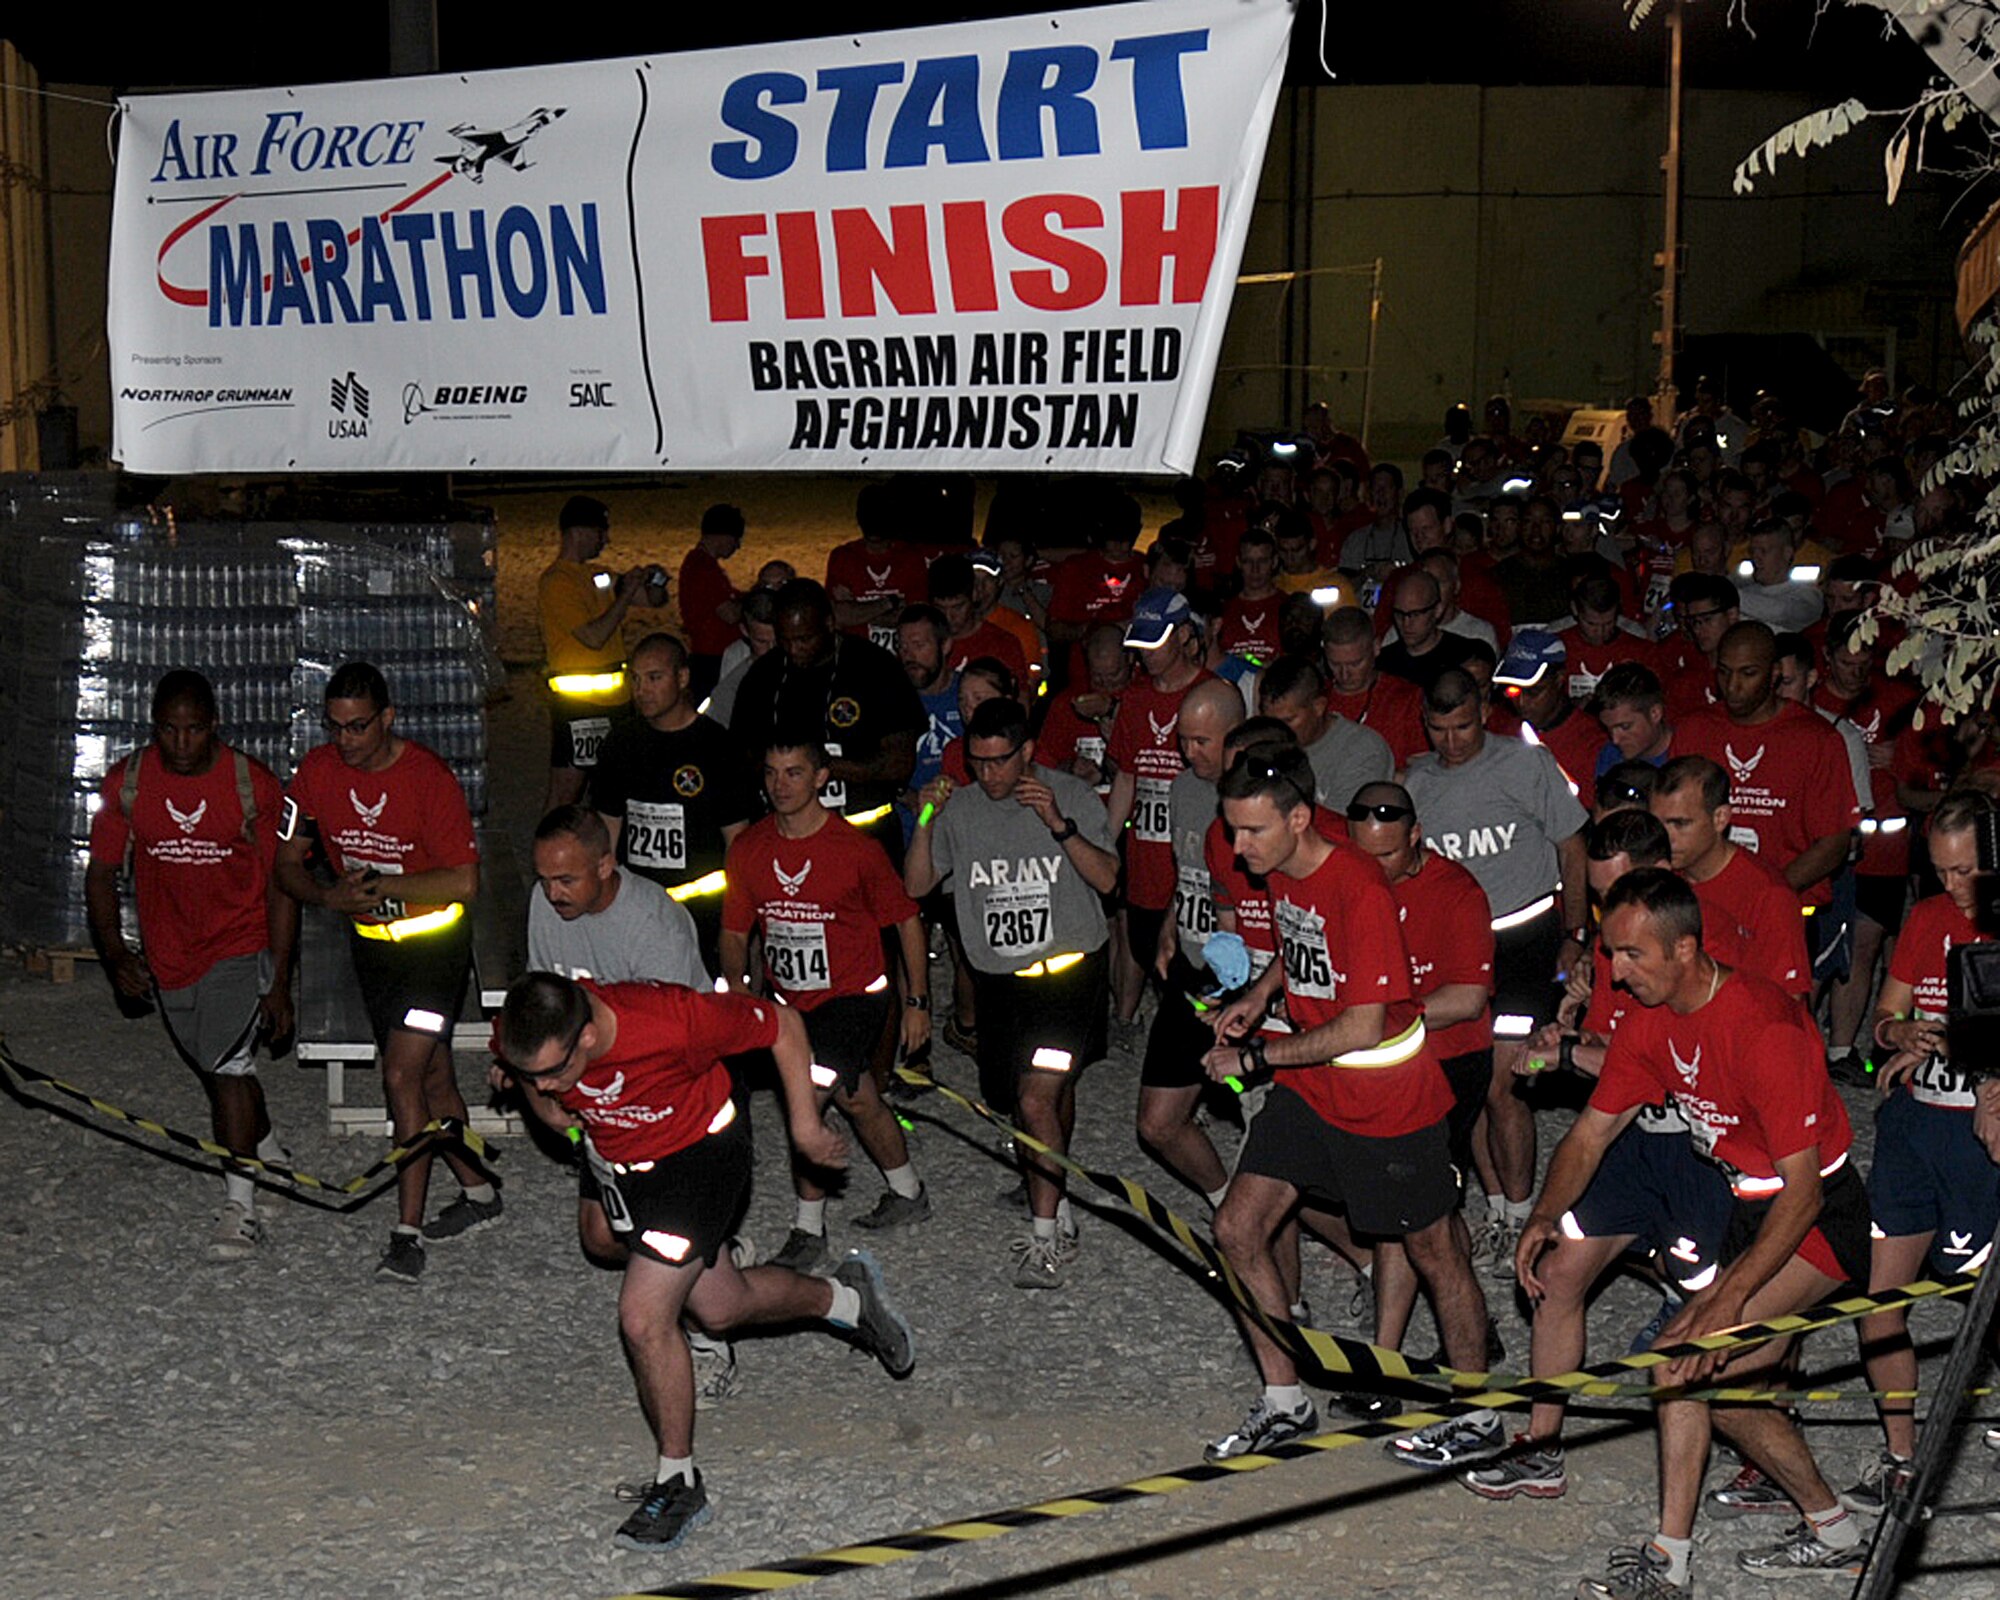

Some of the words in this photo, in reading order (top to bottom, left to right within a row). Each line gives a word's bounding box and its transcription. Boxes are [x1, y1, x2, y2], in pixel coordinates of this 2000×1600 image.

[710, 28, 1211, 179] START
[149, 119, 239, 182] AIR
[250, 111, 424, 175] FORCE
[208, 203, 607, 328] MARATHON
[701, 185, 1219, 322] FINISH
[132, 353, 181, 366] Presenting
[184, 354, 222, 366] Sponsors
[749, 334, 957, 391] BAGRAM
[970, 332, 1048, 386] AIR
[1061, 326, 1181, 383] FIELD
[120, 388, 214, 402] NORTHROP
[216, 389, 293, 402] GRUMMAN
[434, 386, 528, 405] BOEING
[569, 383, 613, 407] SAIC
[328, 420, 368, 439] USAA
[789, 392, 1139, 450] AFGHANISTAN
[1134, 800, 1169, 832] 216
[628, 825, 682, 859] 2246
[1425, 822, 1517, 860] ARMY
[969, 855, 1062, 889] ARMY
[987, 907, 1049, 947] 2367
[766, 945, 827, 980] 2314
